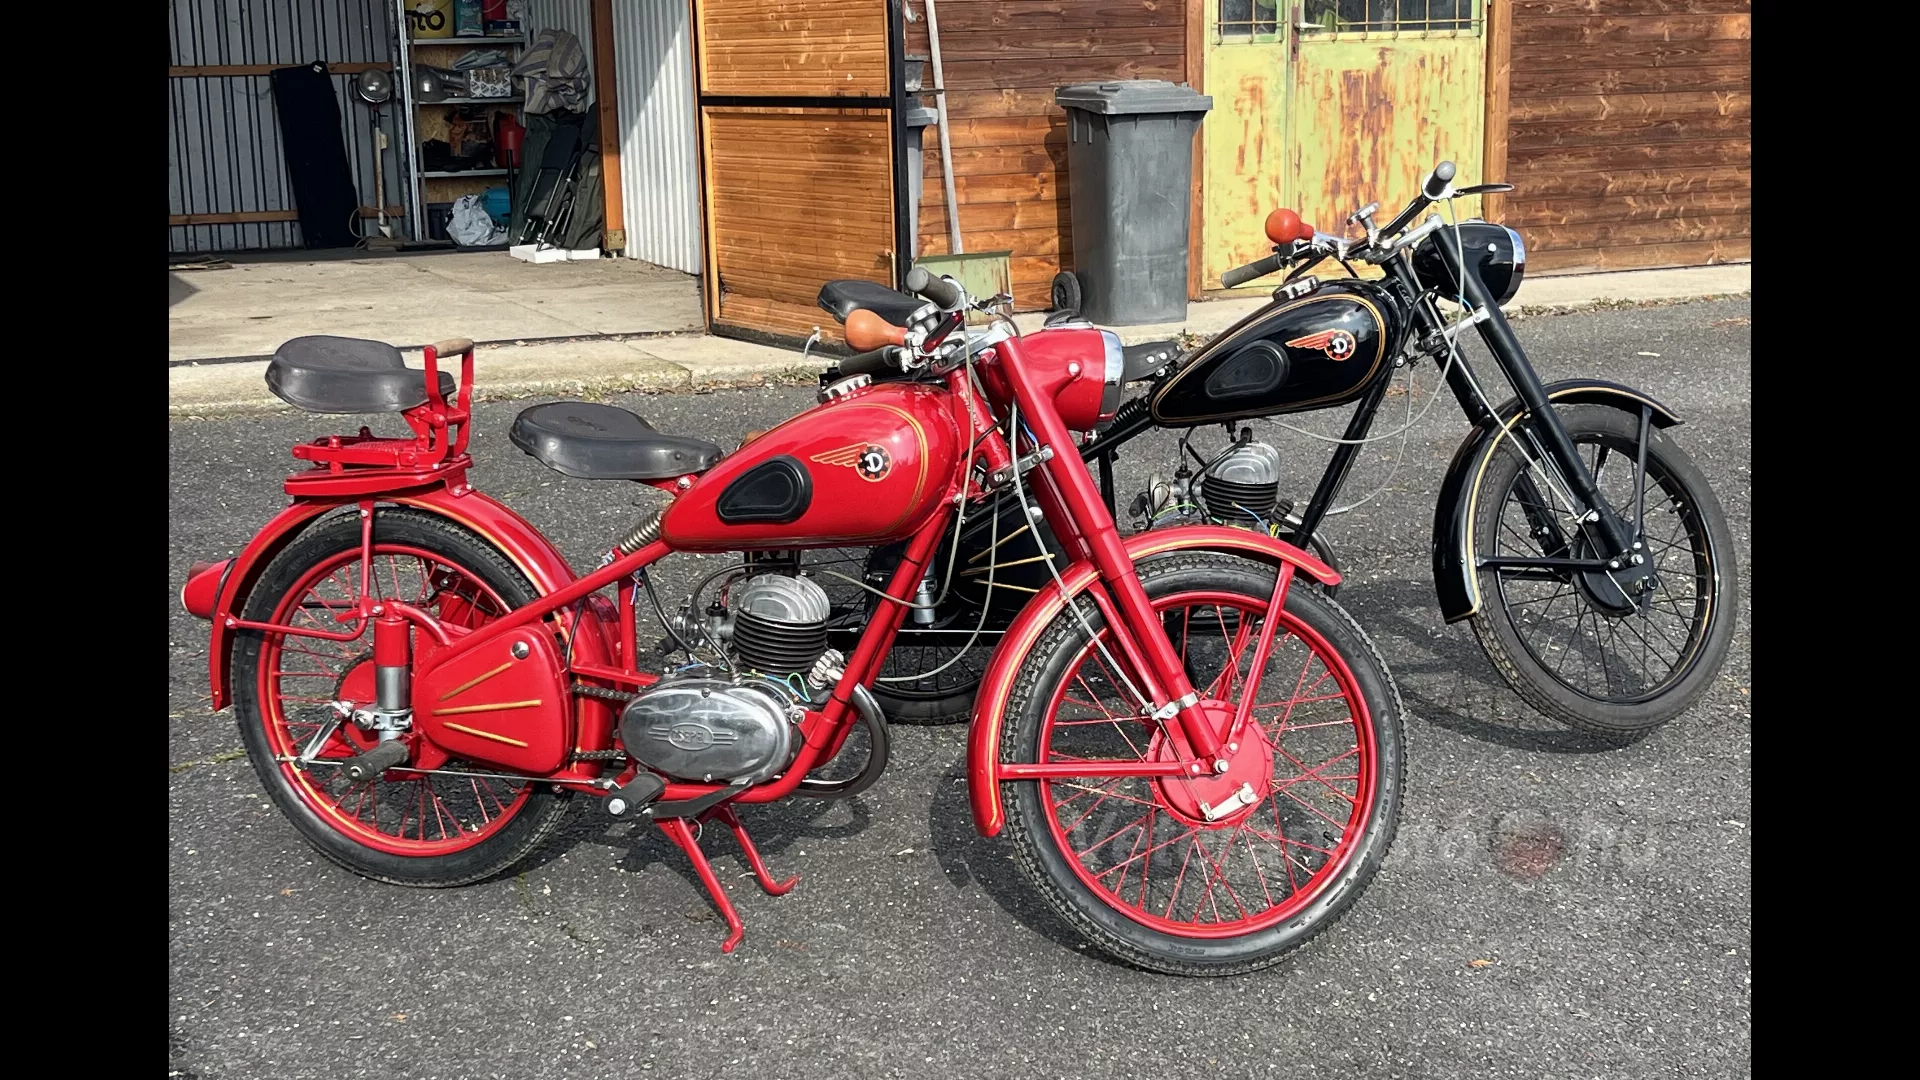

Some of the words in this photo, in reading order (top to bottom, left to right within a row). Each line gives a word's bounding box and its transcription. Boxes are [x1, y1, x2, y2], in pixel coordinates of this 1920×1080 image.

[1332, 337, 1348, 354] D
[864, 452, 884, 472] D
[671, 728, 710, 744] CSEPEL
